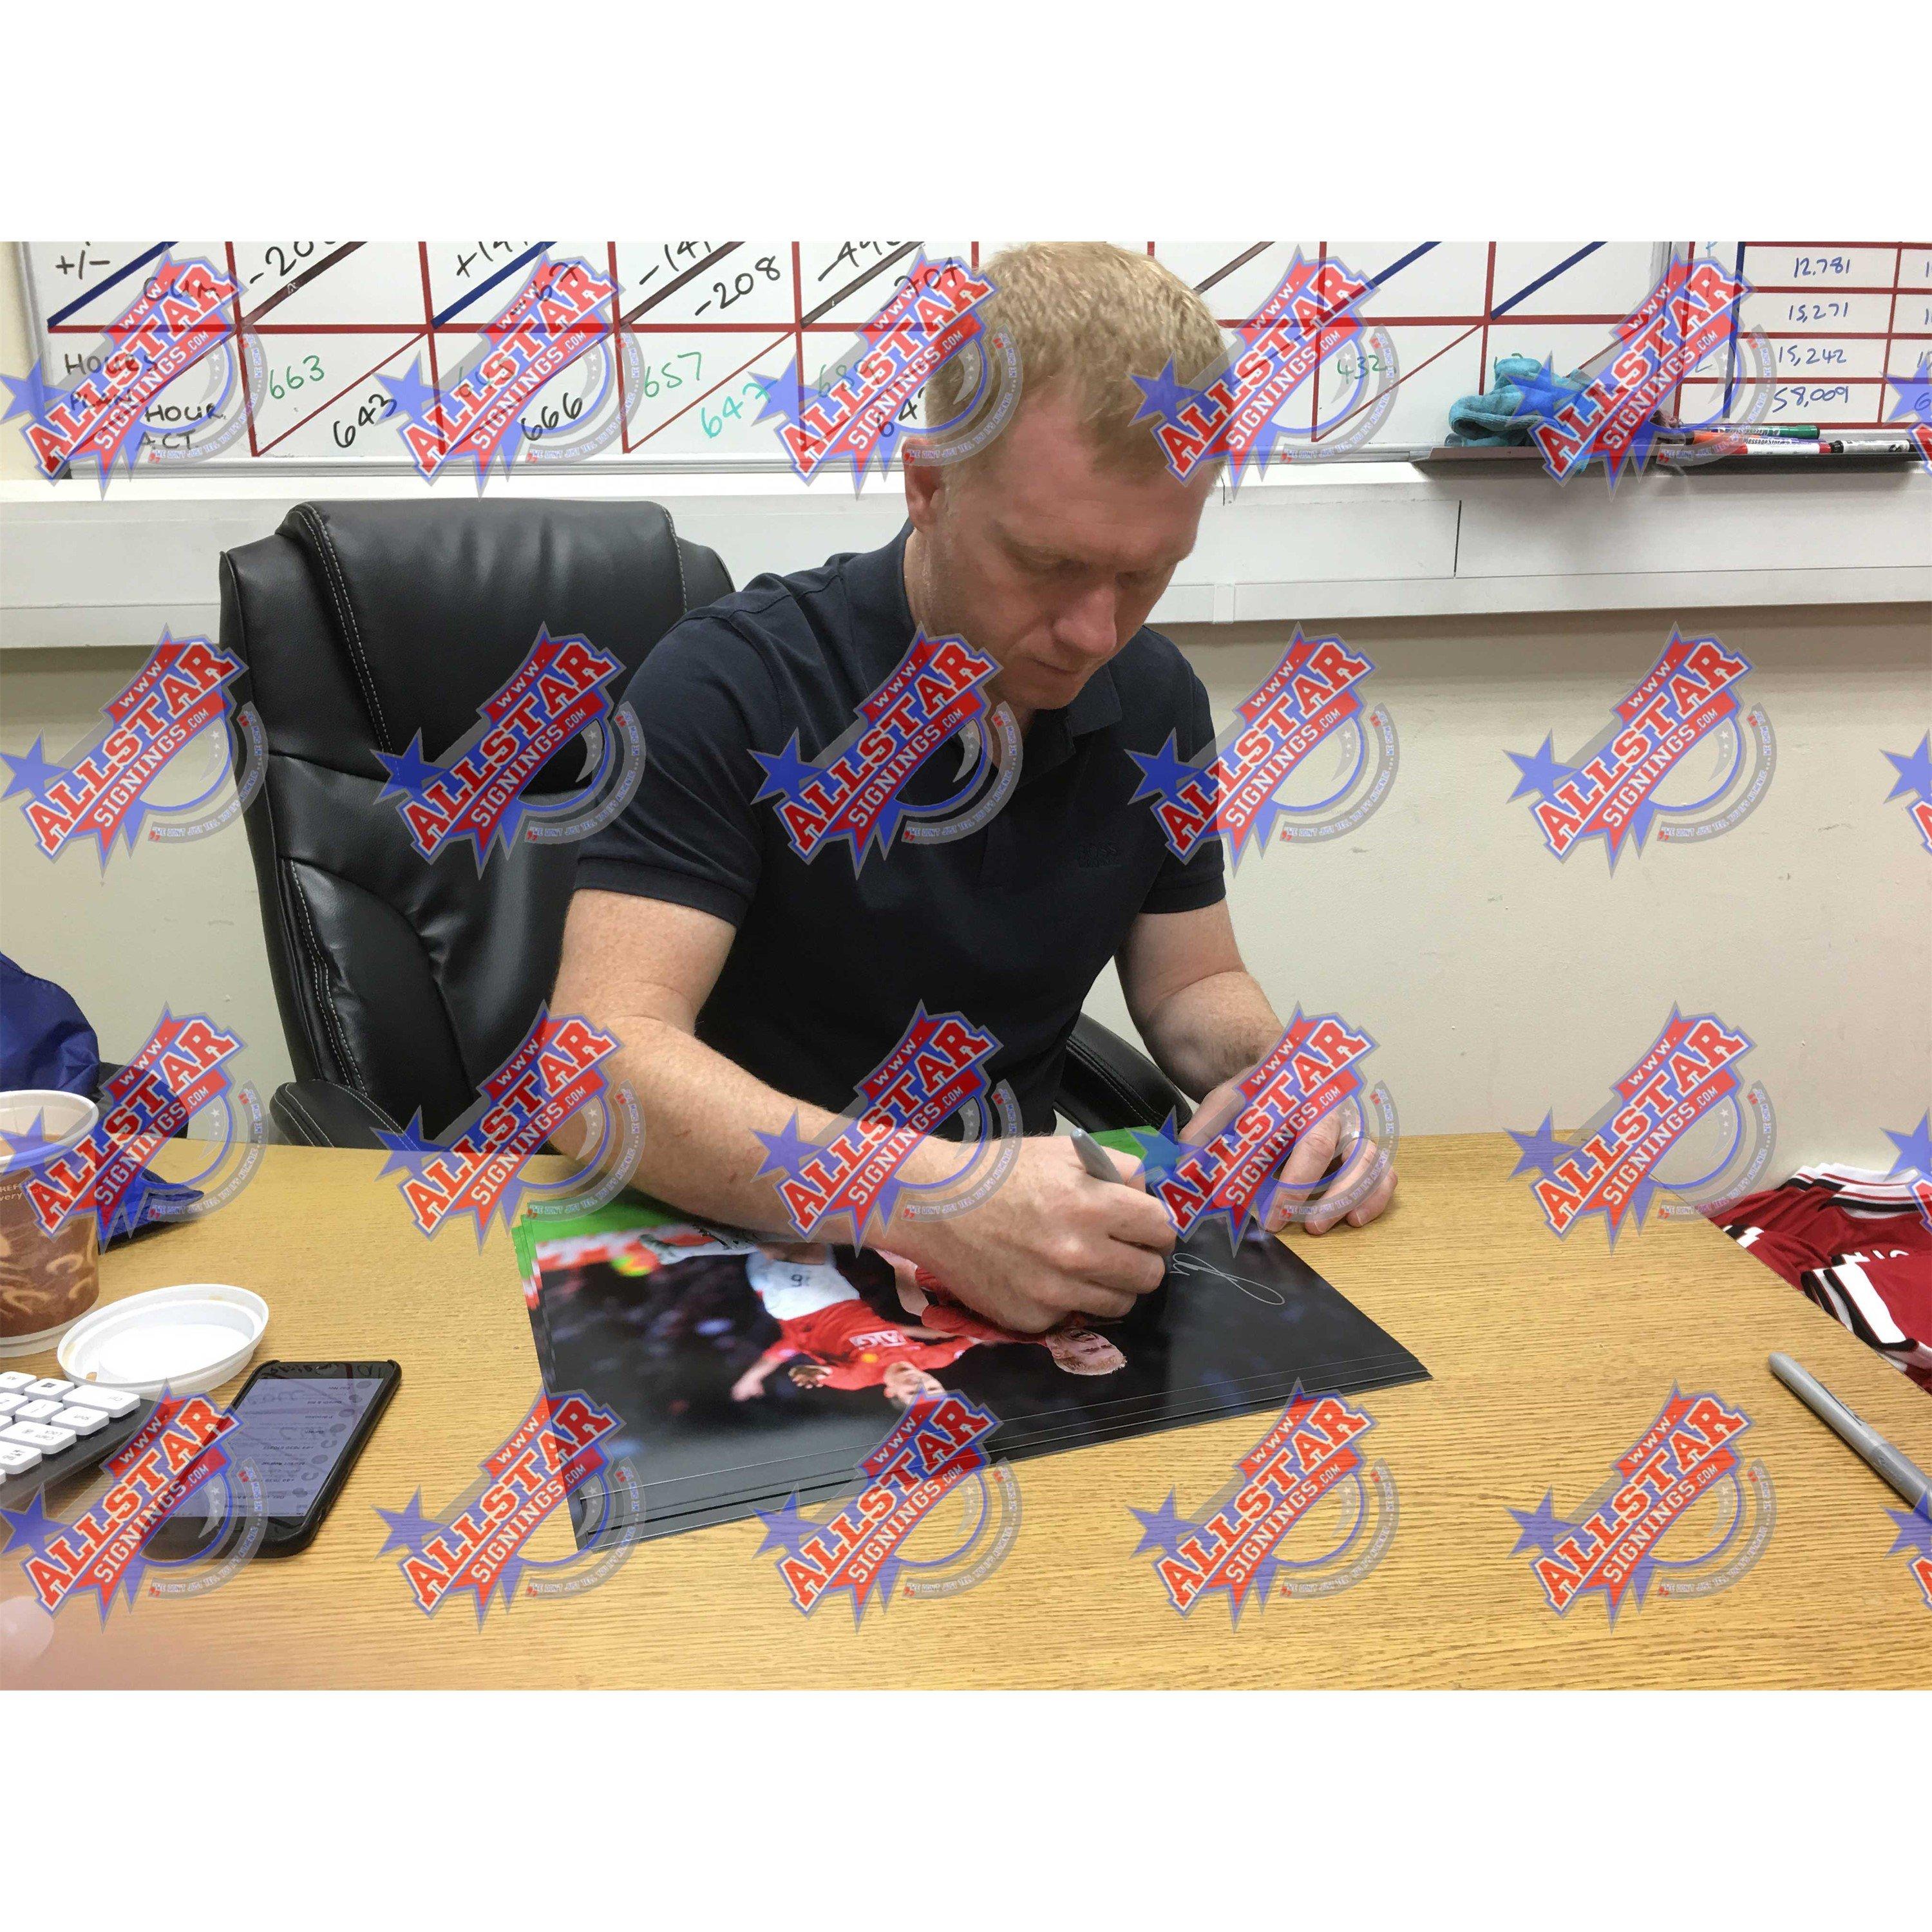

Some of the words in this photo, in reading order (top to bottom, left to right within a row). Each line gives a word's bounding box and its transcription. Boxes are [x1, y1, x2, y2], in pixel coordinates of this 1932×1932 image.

[250, 242, 337, 284] -20
[694, 255, 781, 316] -208
[1788, 301, 1848, 323] 15,271
[269, 355, 325, 399] 663
[644, 352, 701, 397] 657
[1779, 345, 1847, 366] 15,242
[333, 393, 397, 448] 643
[520, 392, 583, 441] 666
[701, 379, 778, 439] 647
[876, 386, 925, 438] 64
[1772, 386, 1849, 413] 58,009
